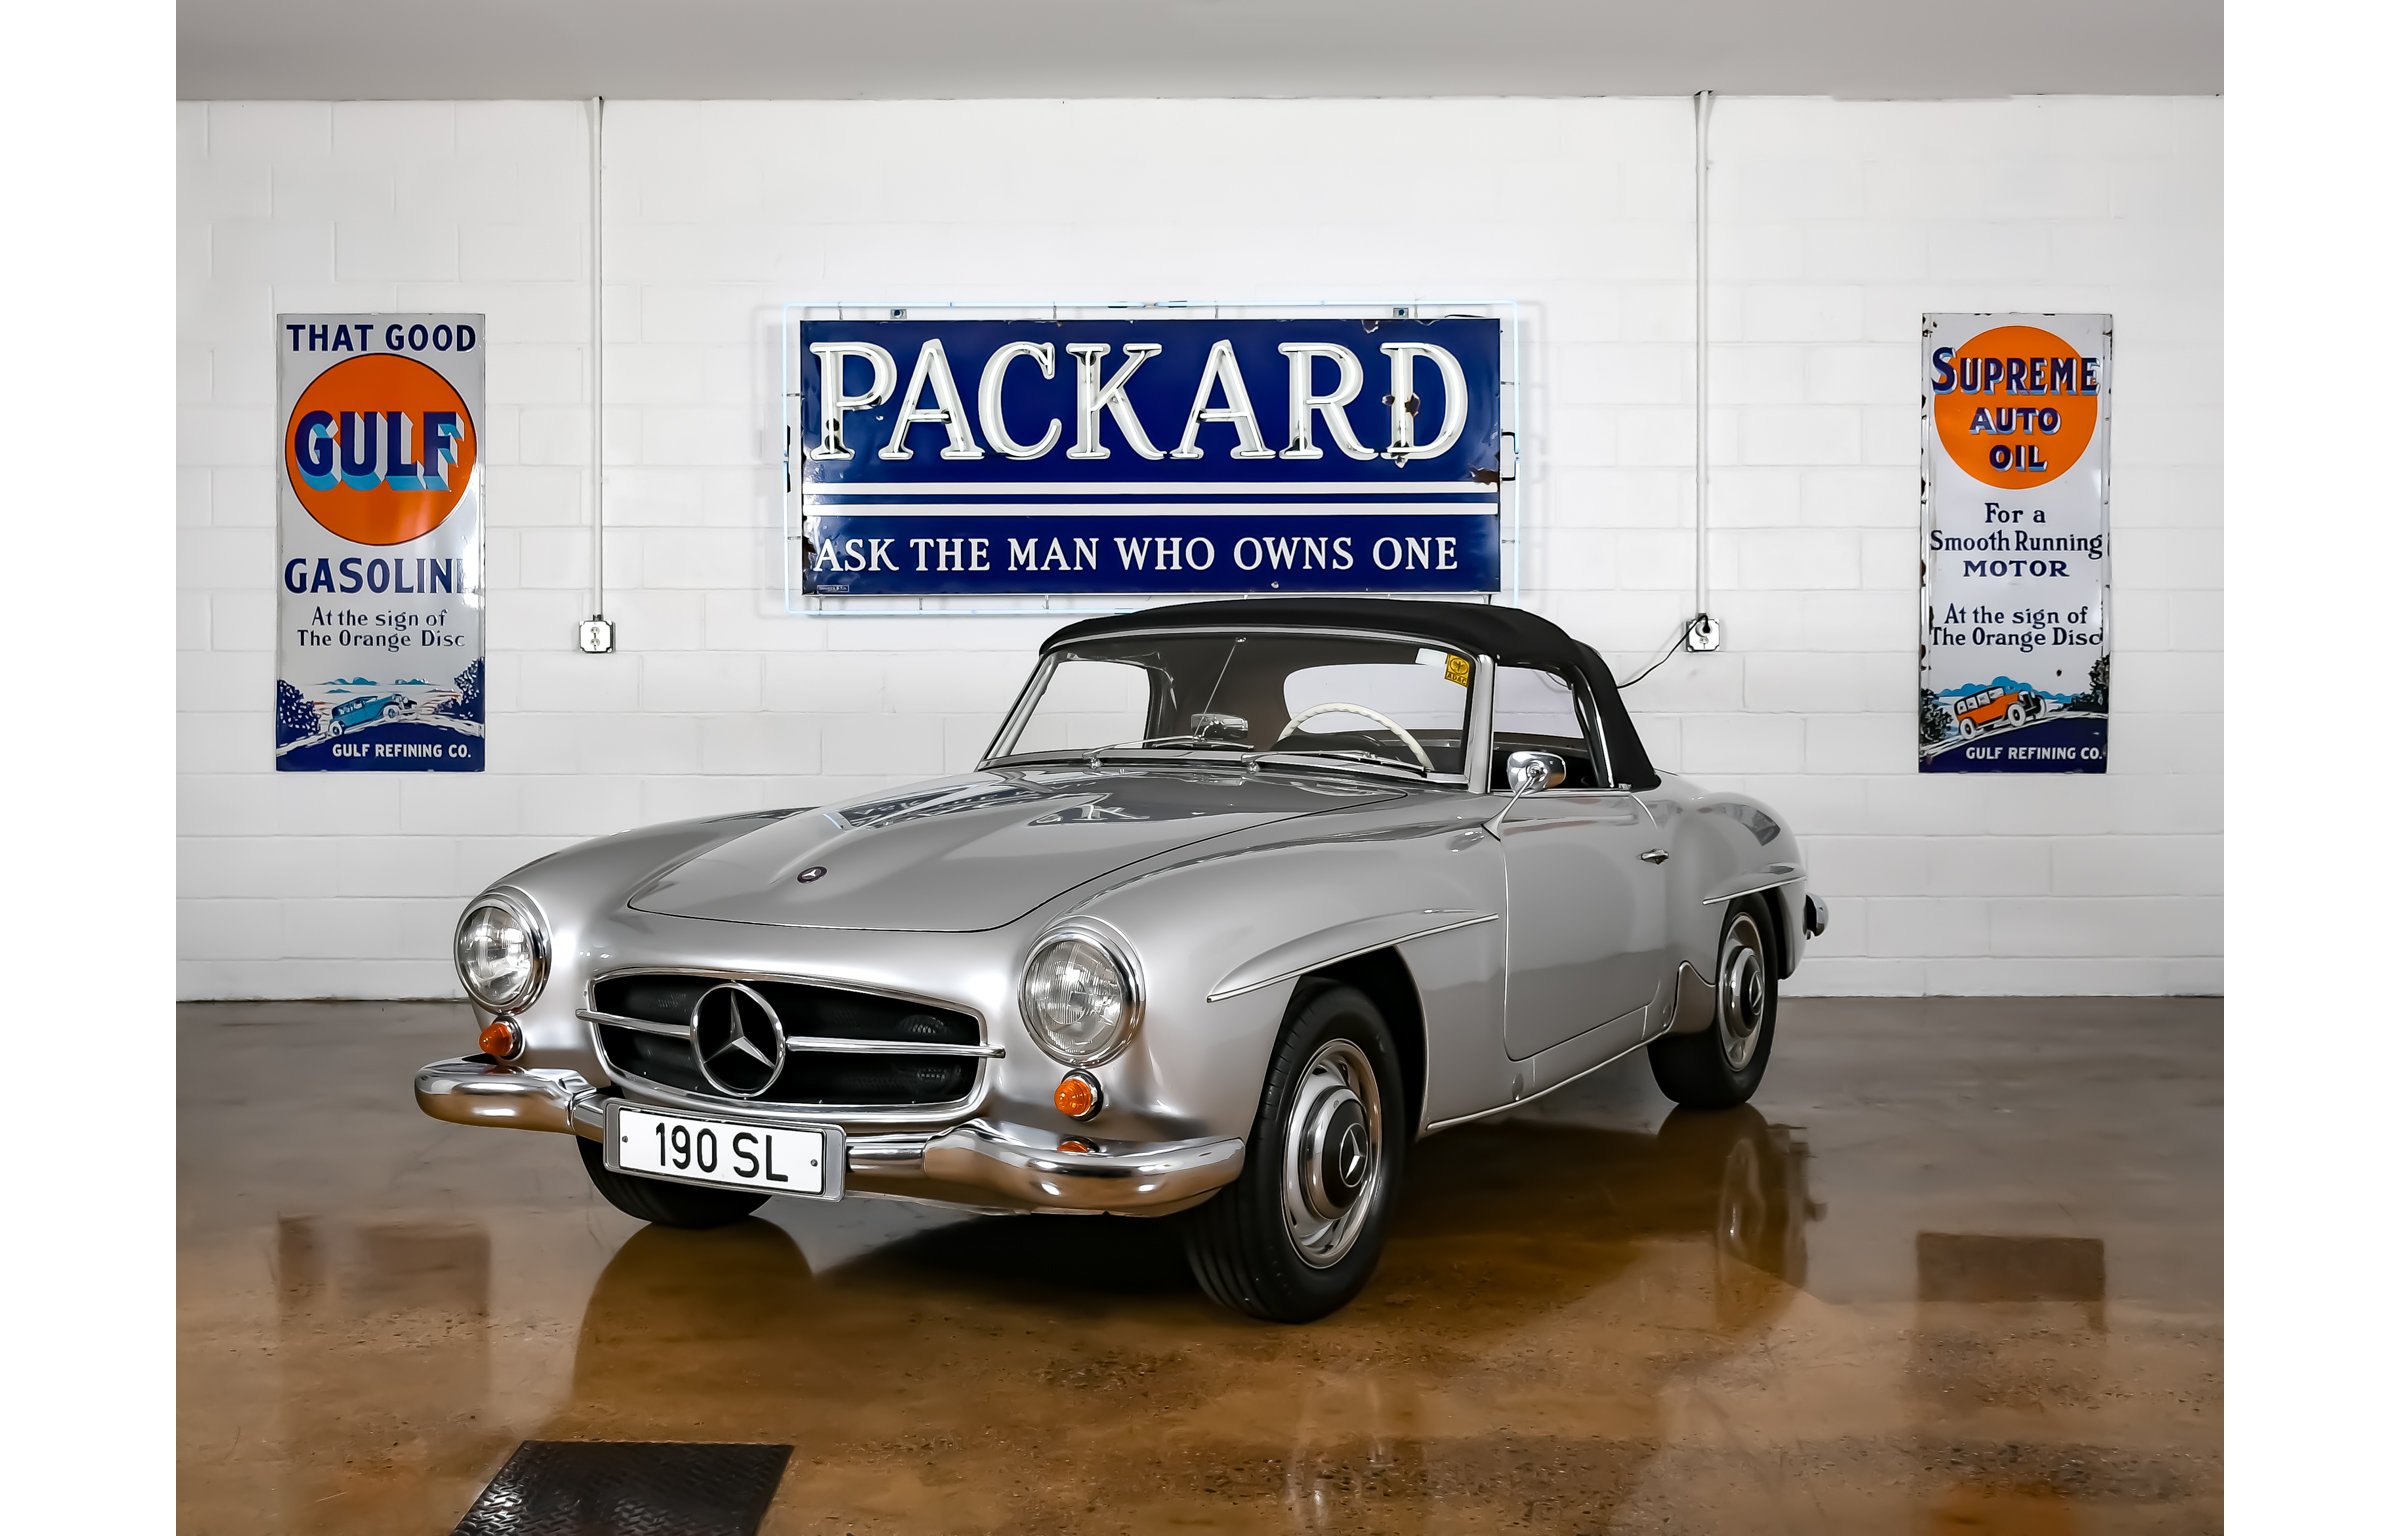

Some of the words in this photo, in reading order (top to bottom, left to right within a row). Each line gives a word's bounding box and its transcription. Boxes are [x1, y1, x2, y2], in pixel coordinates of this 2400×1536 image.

[286, 324, 374, 351] THAT
[385, 324, 476, 352] GOOD
[809, 338, 1469, 461] PACKARD
[1969, 407, 2062, 435] AUTO
[295, 410, 465, 491] GULF
[1989, 445, 2048, 472] OIL
[1984, 502, 2024, 524] For
[2033, 507, 2046, 524] a
[813, 537, 900, 572] ASK
[910, 537, 990, 571] THE
[1007, 538, 1099, 571] MAN
[1114, 537, 1216, 571] WHO
[1233, 537, 1354, 571] OWNS
[1372, 537, 1458, 571] ONE
[1930, 530, 2010, 552] Smooth
[2014, 531, 2103, 560] Running
[1963, 560, 2070, 577] MOTOR
[311, 606, 333, 626] At
[337, 609, 368, 626] the
[375, 610, 419, 631] sign
[426, 609, 448, 626] of
[1944, 603, 1966, 624] At
[1972, 606, 2005, 624] the
[2012, 608, 2059, 629] sign
[2067, 606, 2088, 624] of
[297, 630, 332, 647] The
[339, 630, 411, 652] Orange
[421, 630, 466, 647] Disc
[1931, 627, 1966, 646] The
[1972, 627, 2046, 652] Orange
[2052, 627, 2101, 646] Disc
[332, 744, 369, 757] GULF
[375, 744, 443, 758] REFINING
[448, 744, 472, 758] CO.
[1966, 747, 2003, 760] GULF
[2008, 747, 2076, 760] REFINING
[2080, 747, 2103, 760] CO.
[655, 1122, 718, 1173] 190
[732, 1131, 788, 1183] SL
